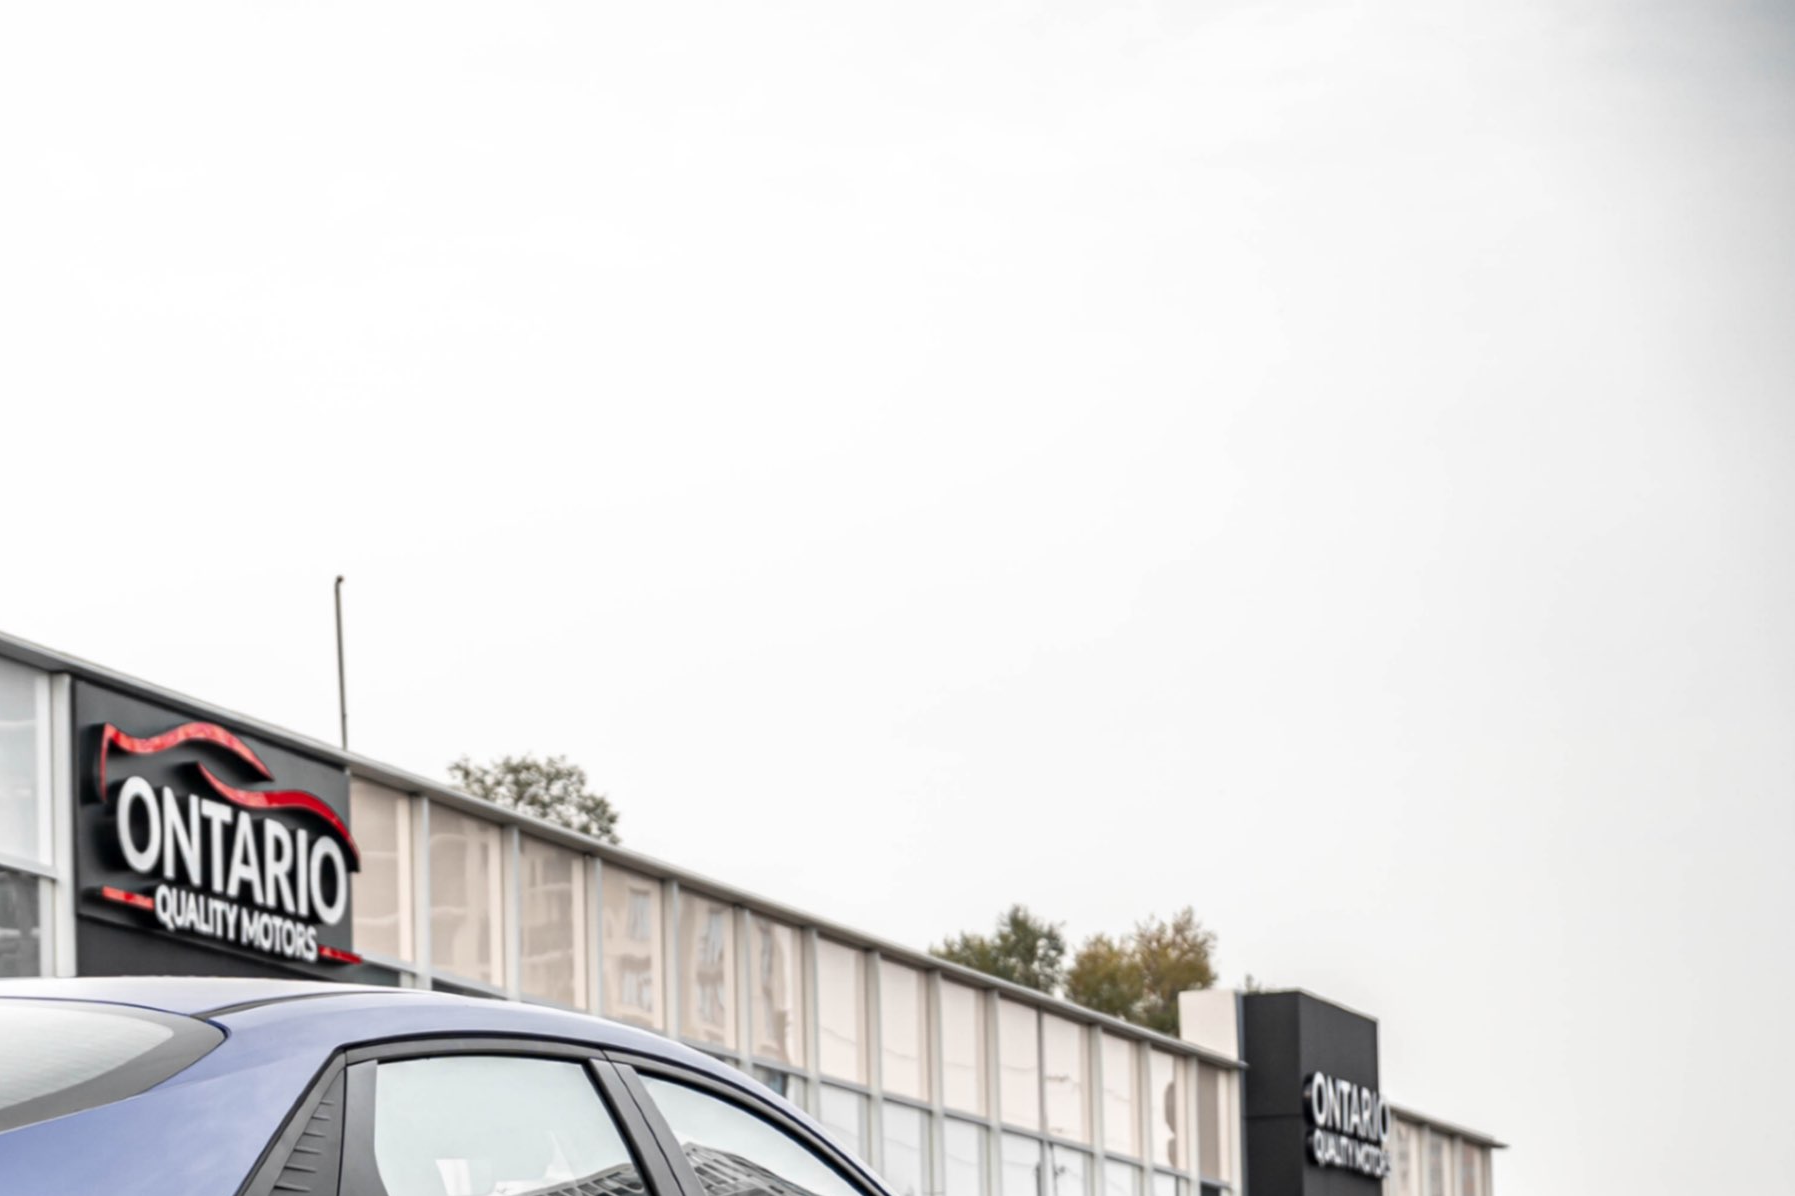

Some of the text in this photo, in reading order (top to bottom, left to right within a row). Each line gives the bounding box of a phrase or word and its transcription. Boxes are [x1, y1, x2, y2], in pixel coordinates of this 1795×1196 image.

[117, 775, 348, 926] ONTARIO
[155, 884, 318, 963] QUALITY MOTORS
[1312, 1071, 1390, 1142] ONTARIO
